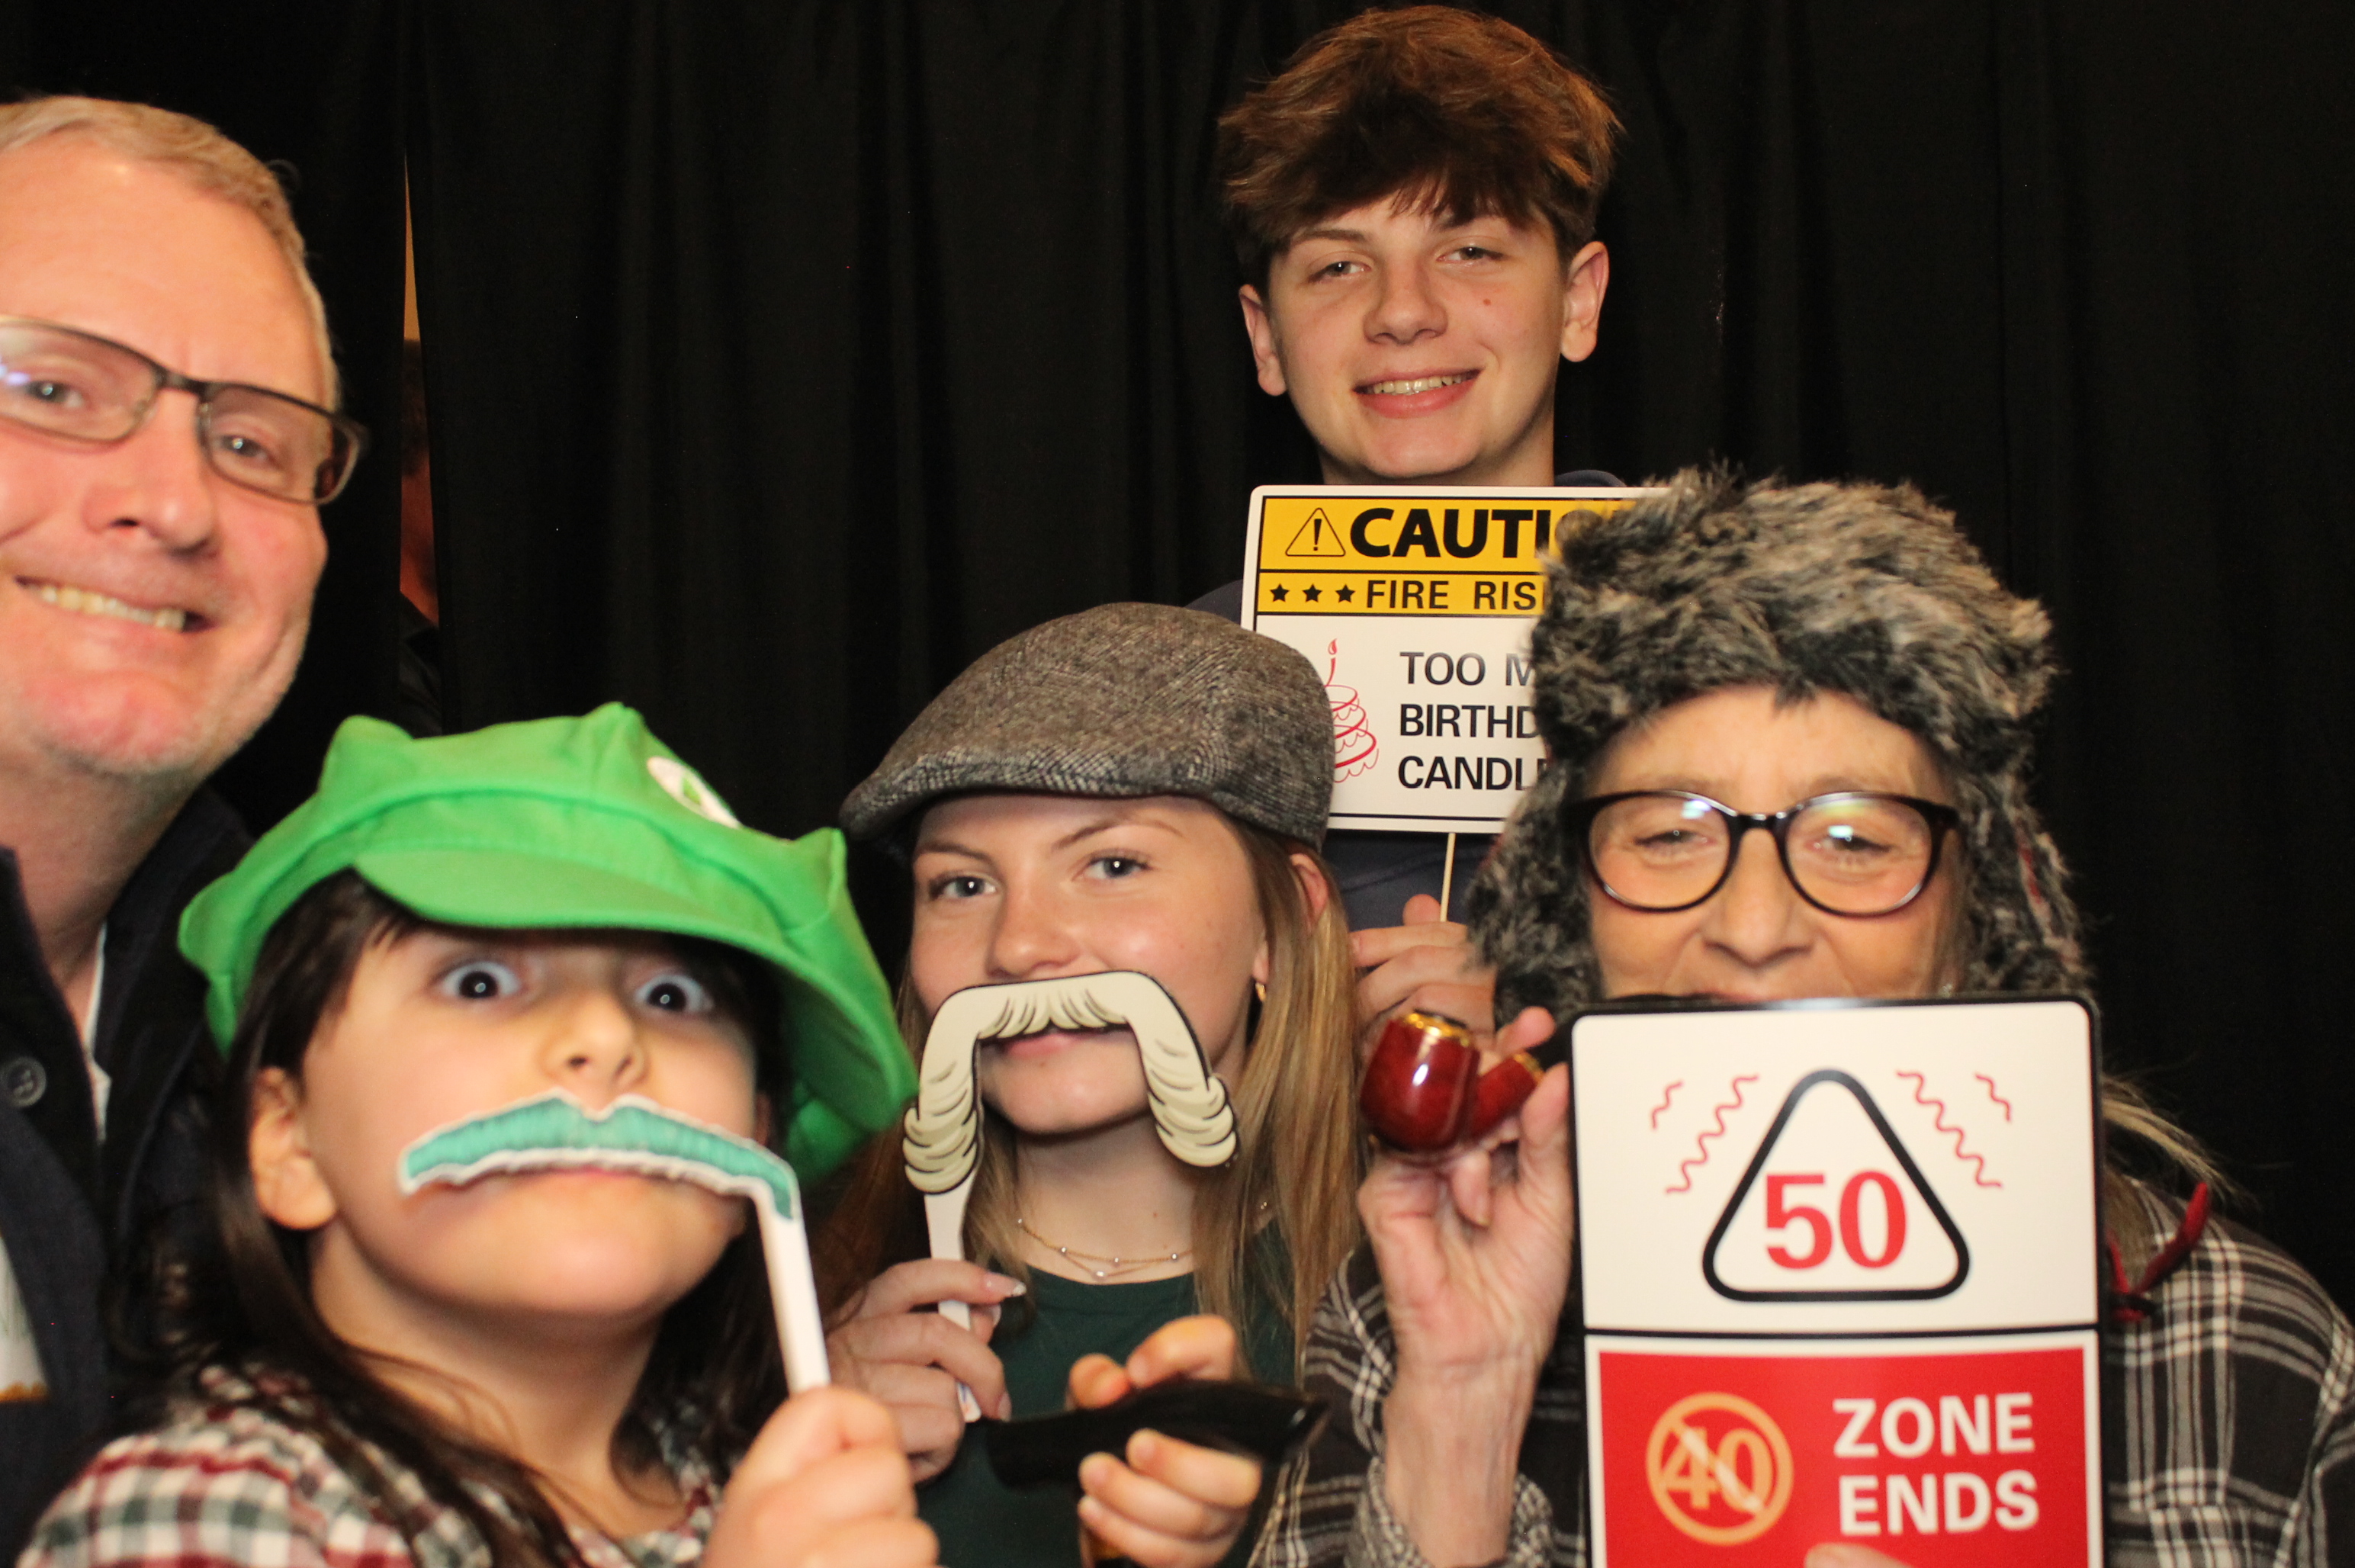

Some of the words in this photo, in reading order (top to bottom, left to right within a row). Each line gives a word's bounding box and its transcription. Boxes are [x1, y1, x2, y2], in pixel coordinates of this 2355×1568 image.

[1367, 580, 1449, 609] FIRE
[1474, 581, 1546, 611] RIS
[1399, 652, 1486, 685] TOO
[1400, 704, 1541, 738] BIRTHD
[1764, 1170, 1907, 1271] 50
[1833, 1393, 2035, 1459] ZONE
[1661, 1425, 1773, 1512] 40
[1839, 1470, 2040, 1536] ENDS
